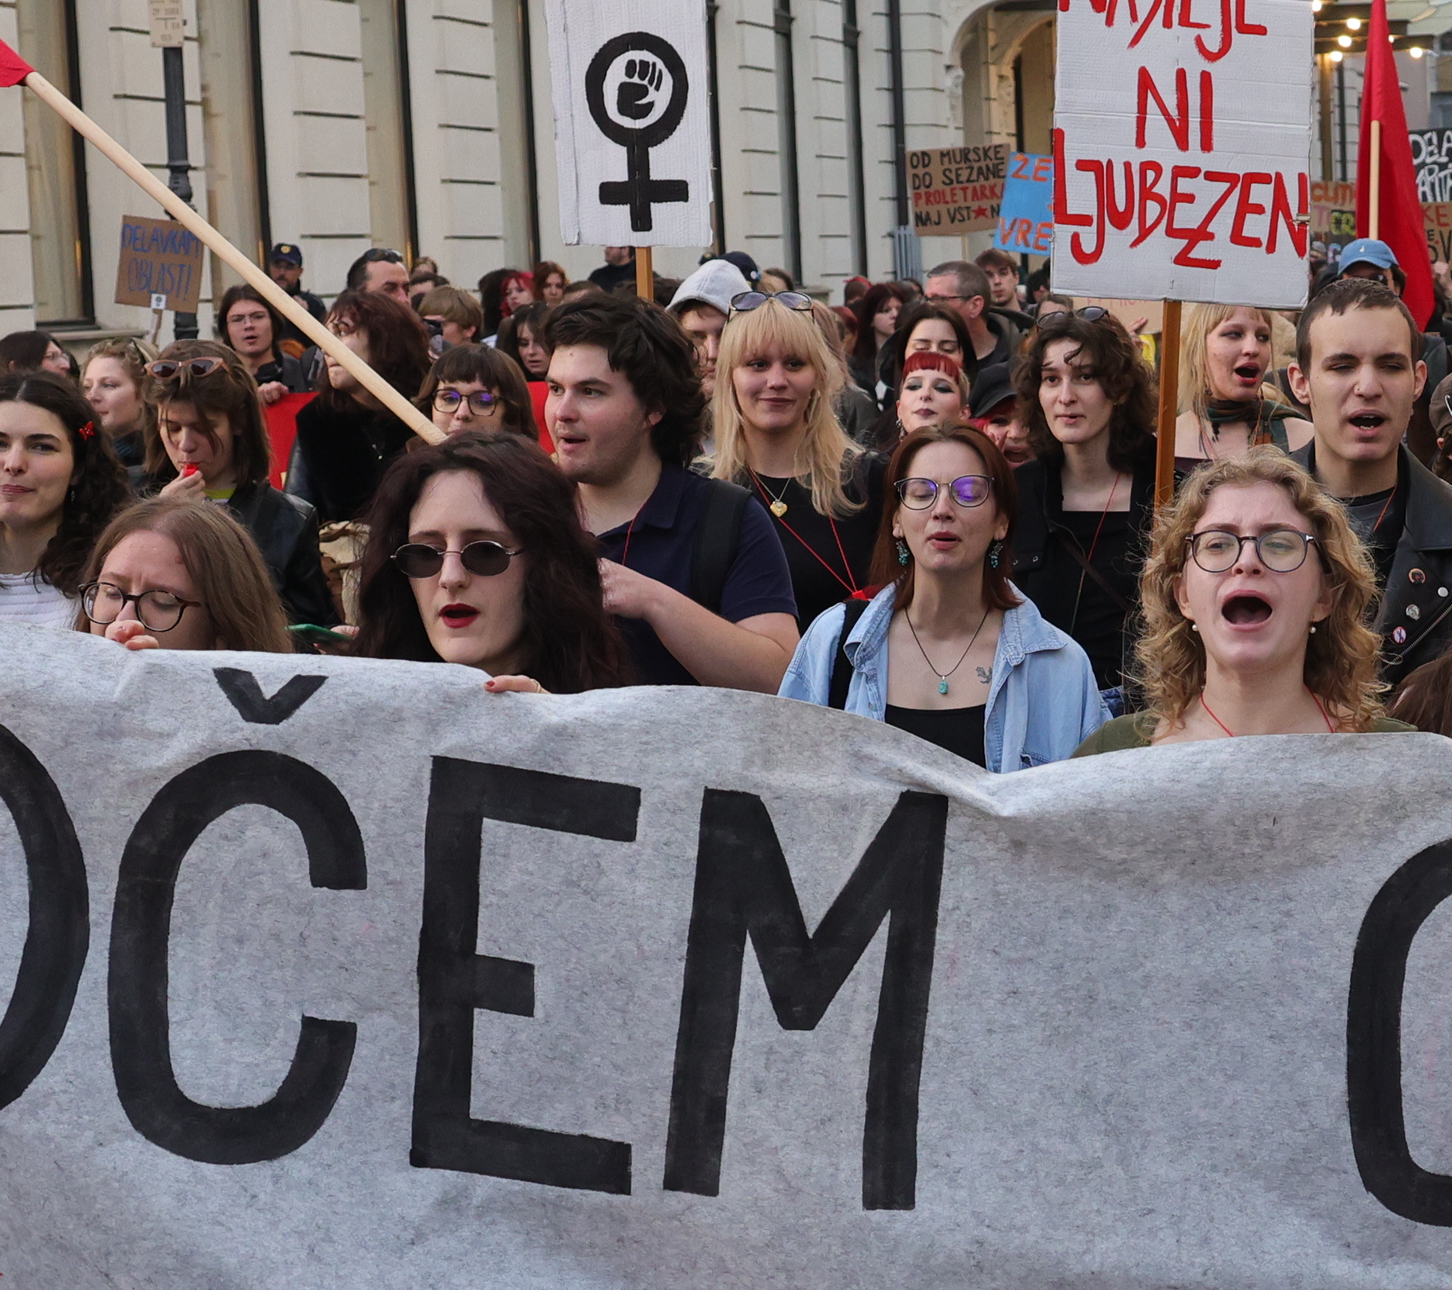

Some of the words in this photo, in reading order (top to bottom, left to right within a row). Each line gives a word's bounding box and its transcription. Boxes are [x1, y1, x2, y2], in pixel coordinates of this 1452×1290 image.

[1135, 65, 1214, 153] NI
[910, 151, 931, 169] OD
[939, 144, 1005, 166] MURSKE
[912, 172, 932, 190] DO
[1052, 128, 1308, 270] LJUBEZEN
[915, 209, 941, 227] NAJ
